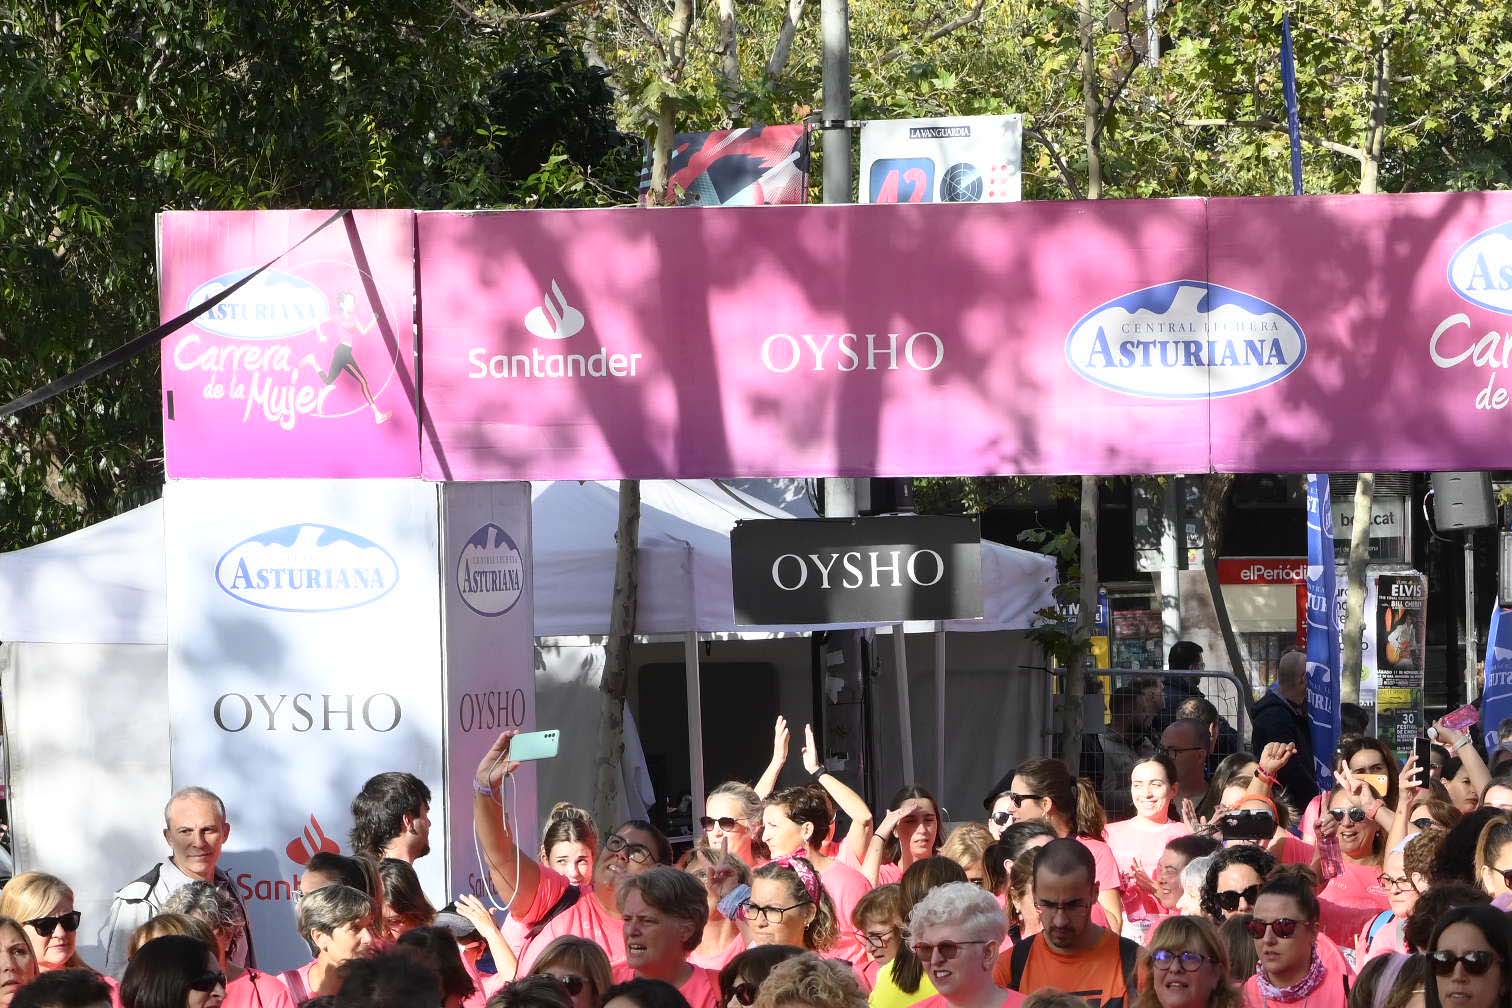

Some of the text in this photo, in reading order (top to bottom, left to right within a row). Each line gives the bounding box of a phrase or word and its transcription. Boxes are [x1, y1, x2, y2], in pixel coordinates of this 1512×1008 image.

[921, 126, 971, 138] VANGUARDIA
[1121, 322, 1197, 334] CENTRAL
[173, 335, 291, 372] Carrera
[468, 348, 642, 378] Santander
[761, 331, 945, 373] OYSHO
[1087, 325, 1288, 369] ASTURIANA
[203, 370, 336, 430] de la Mujer
[1475, 372, 1510, 410] de
[229, 556, 386, 590] ASTURIANA
[462, 558, 521, 594] ASTURIANA
[771, 549, 945, 592] OYSHO
[1391, 584, 1422, 597] ELVIS
[213, 692, 402, 733] OYSHO
[459, 688, 526, 733] OYSHO
[1402, 713, 1415, 725] 30
